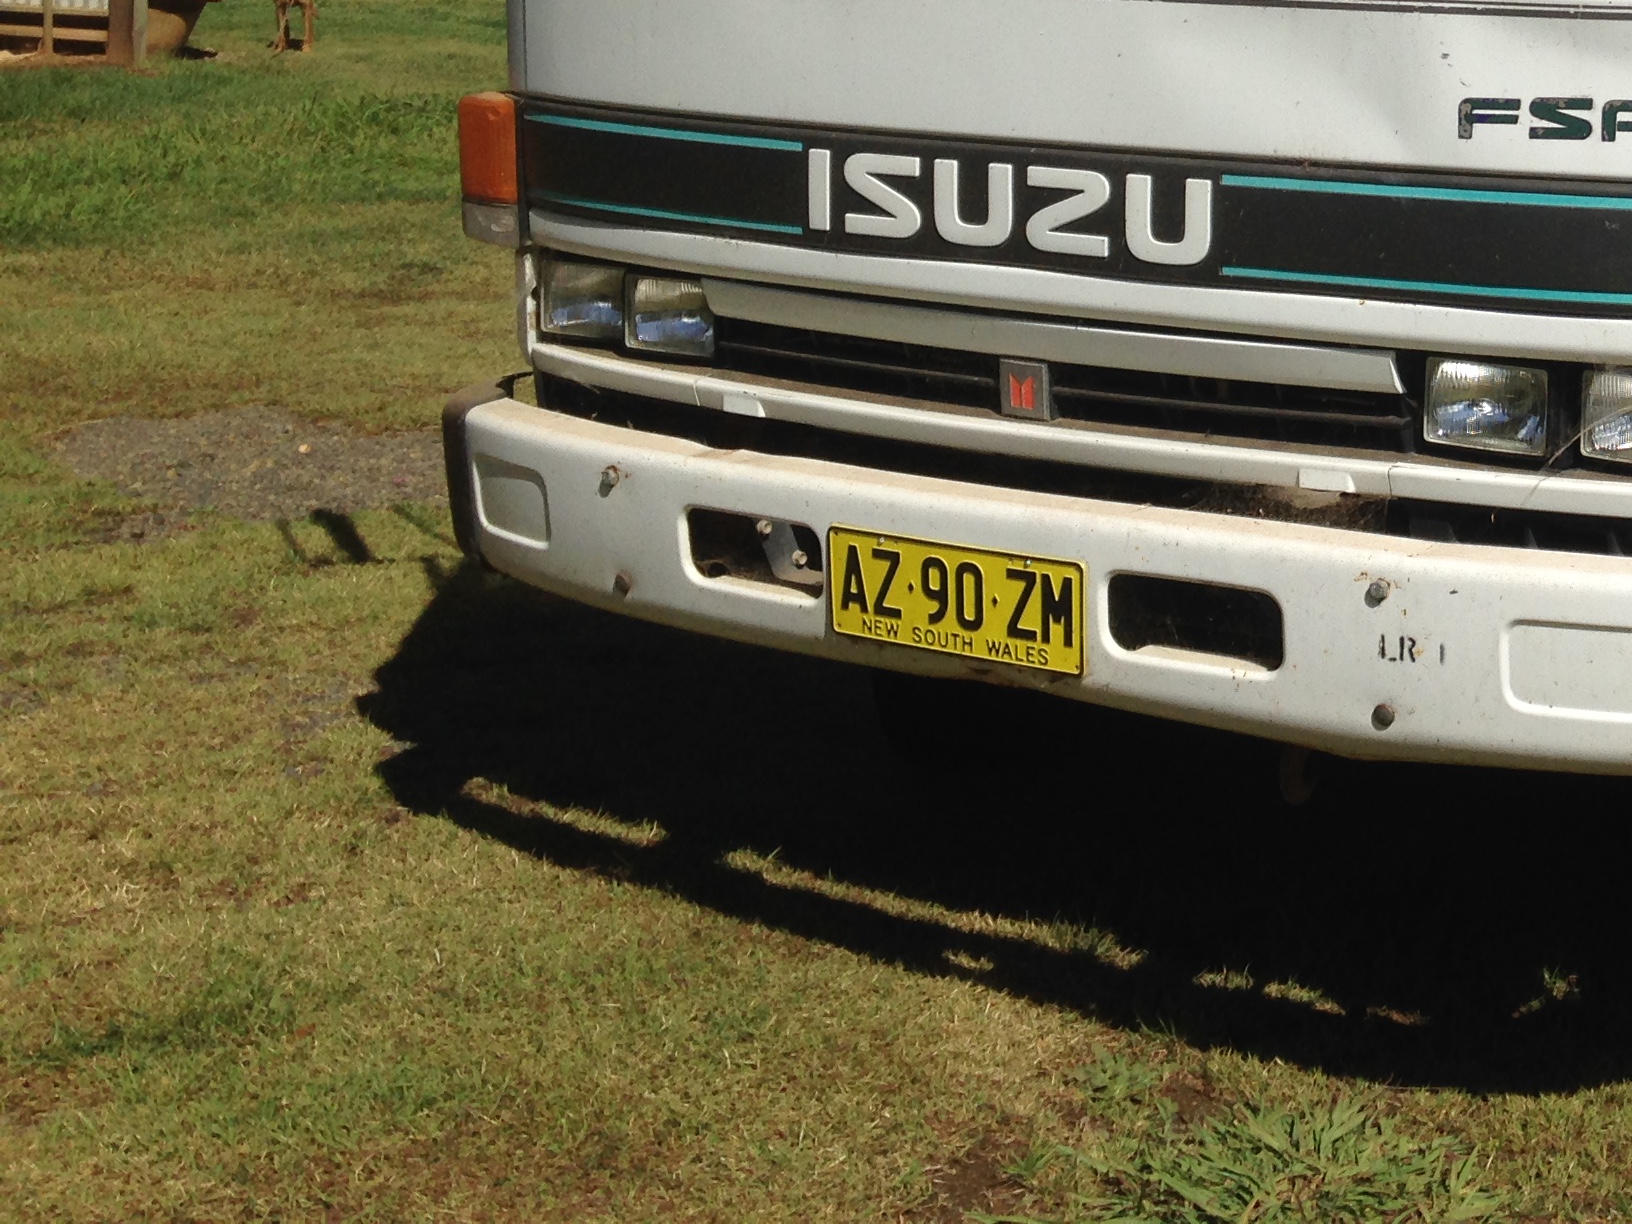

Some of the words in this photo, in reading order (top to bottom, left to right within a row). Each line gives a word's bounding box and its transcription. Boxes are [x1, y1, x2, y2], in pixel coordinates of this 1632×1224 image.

[807, 148, 1215, 266] ISUZU
[861, 616, 900, 639] NEW
[911, 625, 975, 654] SOUTH
[985, 639, 1050, 666] WALES
